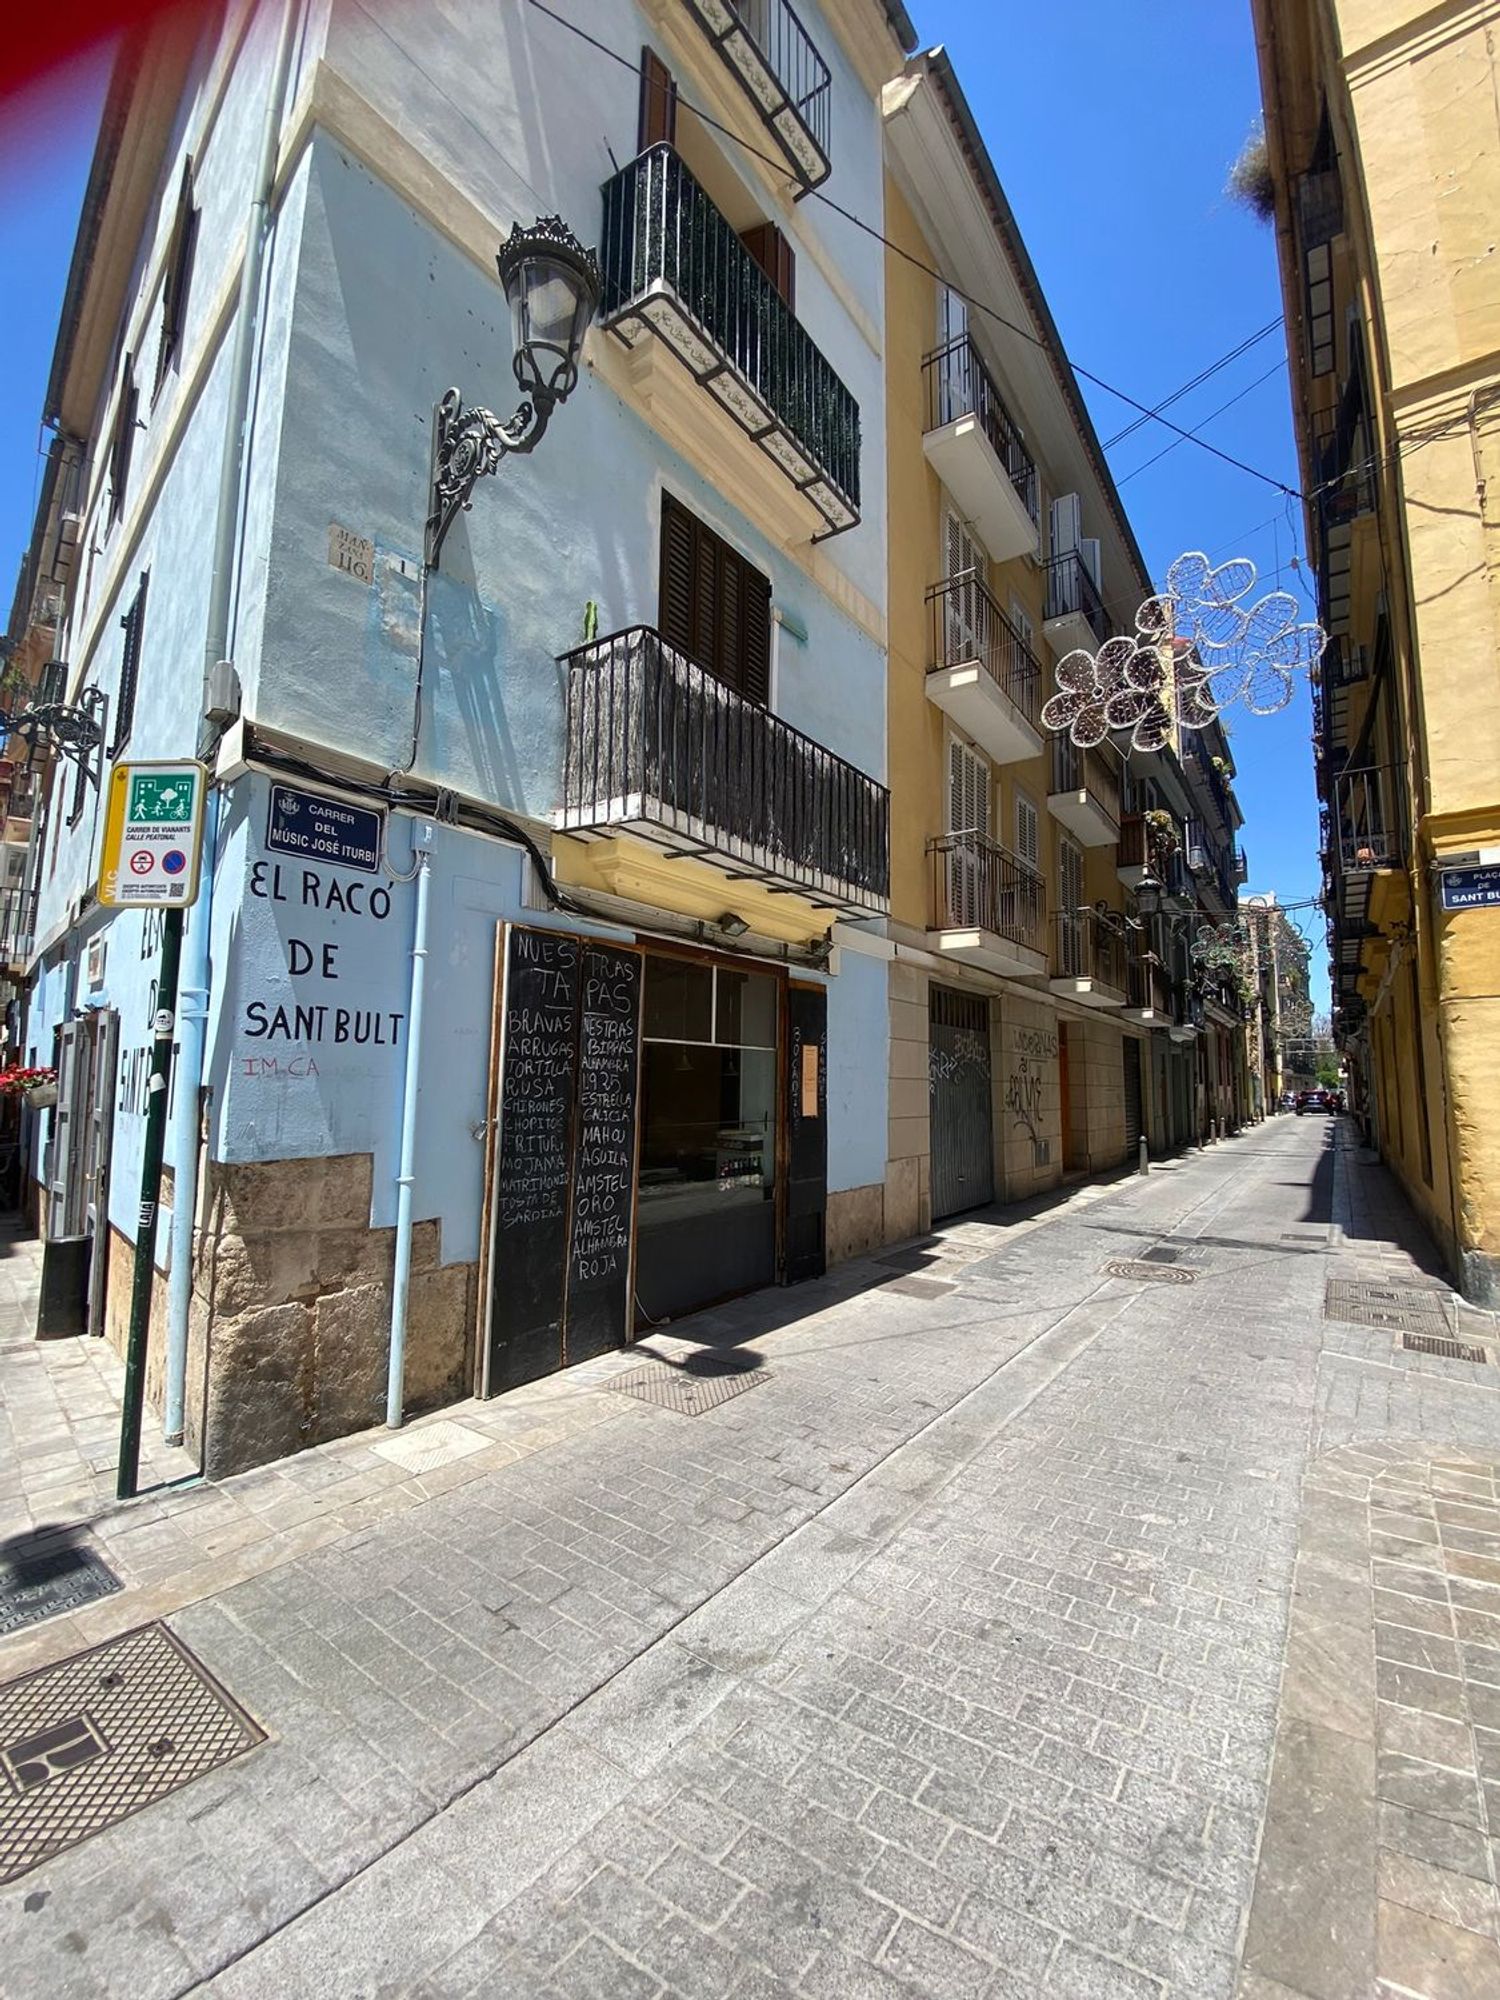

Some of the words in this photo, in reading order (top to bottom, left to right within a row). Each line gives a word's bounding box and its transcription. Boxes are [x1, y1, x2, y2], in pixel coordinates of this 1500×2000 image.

[308, 804, 355, 825] CARRER
[315, 822, 338, 836] DEL
[272, 828, 309, 847] MÚSIC
[311, 838, 339, 855] JOSÉ
[342, 845, 375, 863] ITURBI
[250, 861, 287, 901] EL
[302, 871, 394, 920] RACÓ
[1452, 892, 1483, 903] SANT
[288, 939, 339, 979] DE
[586, 951, 634, 981] TRAS
[531, 967, 571, 1000] TA
[587, 979, 631, 1013] PAS
[244, 1001, 329, 1042] SANT
[334, 1008, 404, 1045] BULT
[508, 1008, 572, 1035] BRAVAS
[508, 1037, 575, 1058] ARRUGAS
[507, 1058, 573, 1077] TORTILLA
[505, 1077, 555, 1098] RUSA
[575, 1172, 628, 1196] AMSTEL
[577, 1195, 615, 1217] ORO
[574, 1214, 624, 1240] AMSTEL
[579, 1254, 617, 1281] ROJA
